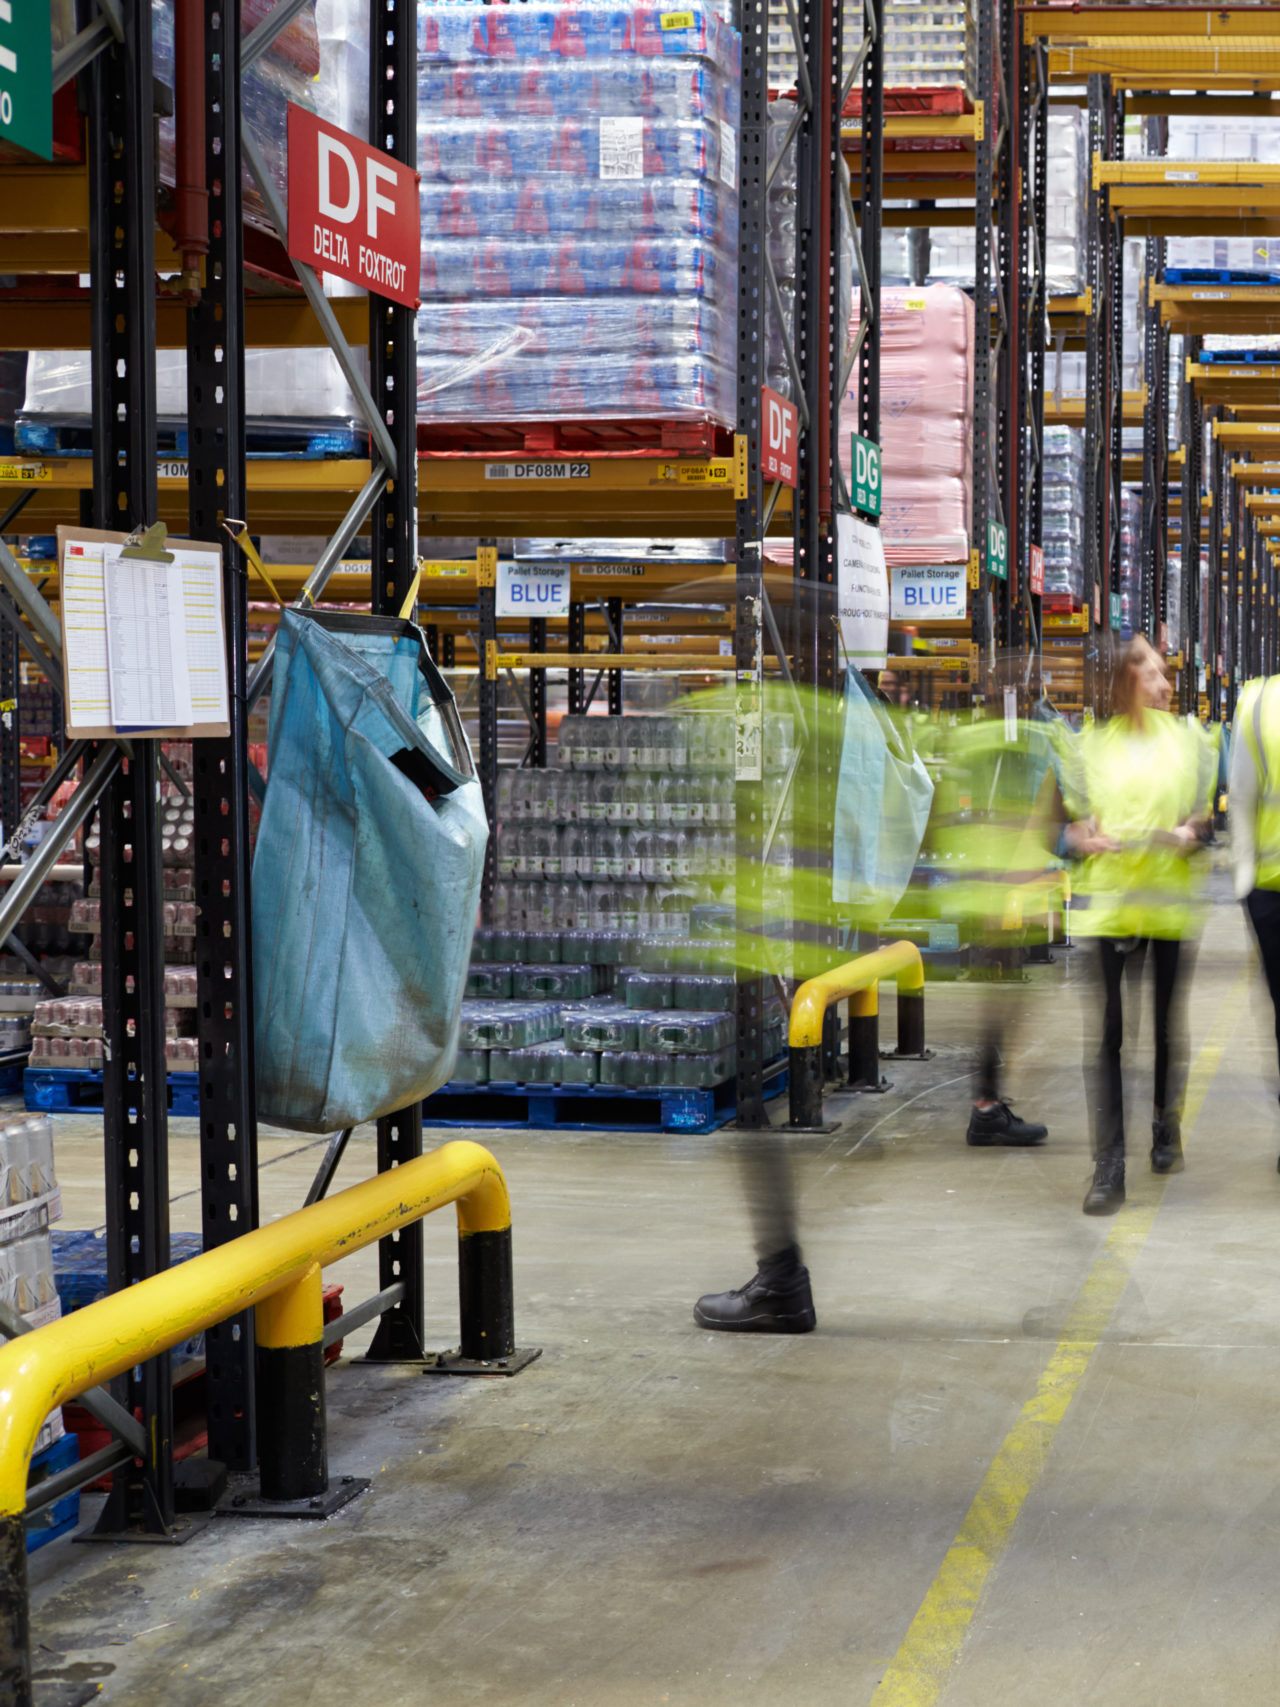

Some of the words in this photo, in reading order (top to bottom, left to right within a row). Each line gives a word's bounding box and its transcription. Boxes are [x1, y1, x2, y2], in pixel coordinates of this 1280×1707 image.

[317, 130, 398, 240] DF
[313, 224, 350, 268] DELTA
[358, 245, 407, 293] FOXTROT
[769, 400, 792, 454] DF
[514, 464, 566, 477] DF08M
[571, 464, 591, 477] 22
[856, 441, 879, 491] DG
[990, 525, 1006, 561] DG
[508, 566, 531, 576] Pallet
[533, 565, 566, 577] Storage
[597, 566, 632, 574] DG10M
[901, 569, 925, 579] Pallet
[927, 569, 960, 579] Storage
[1032, 549, 1043, 579] DH
[510, 584, 562, 602] BLUE
[904, 586, 957, 606] BLUE
